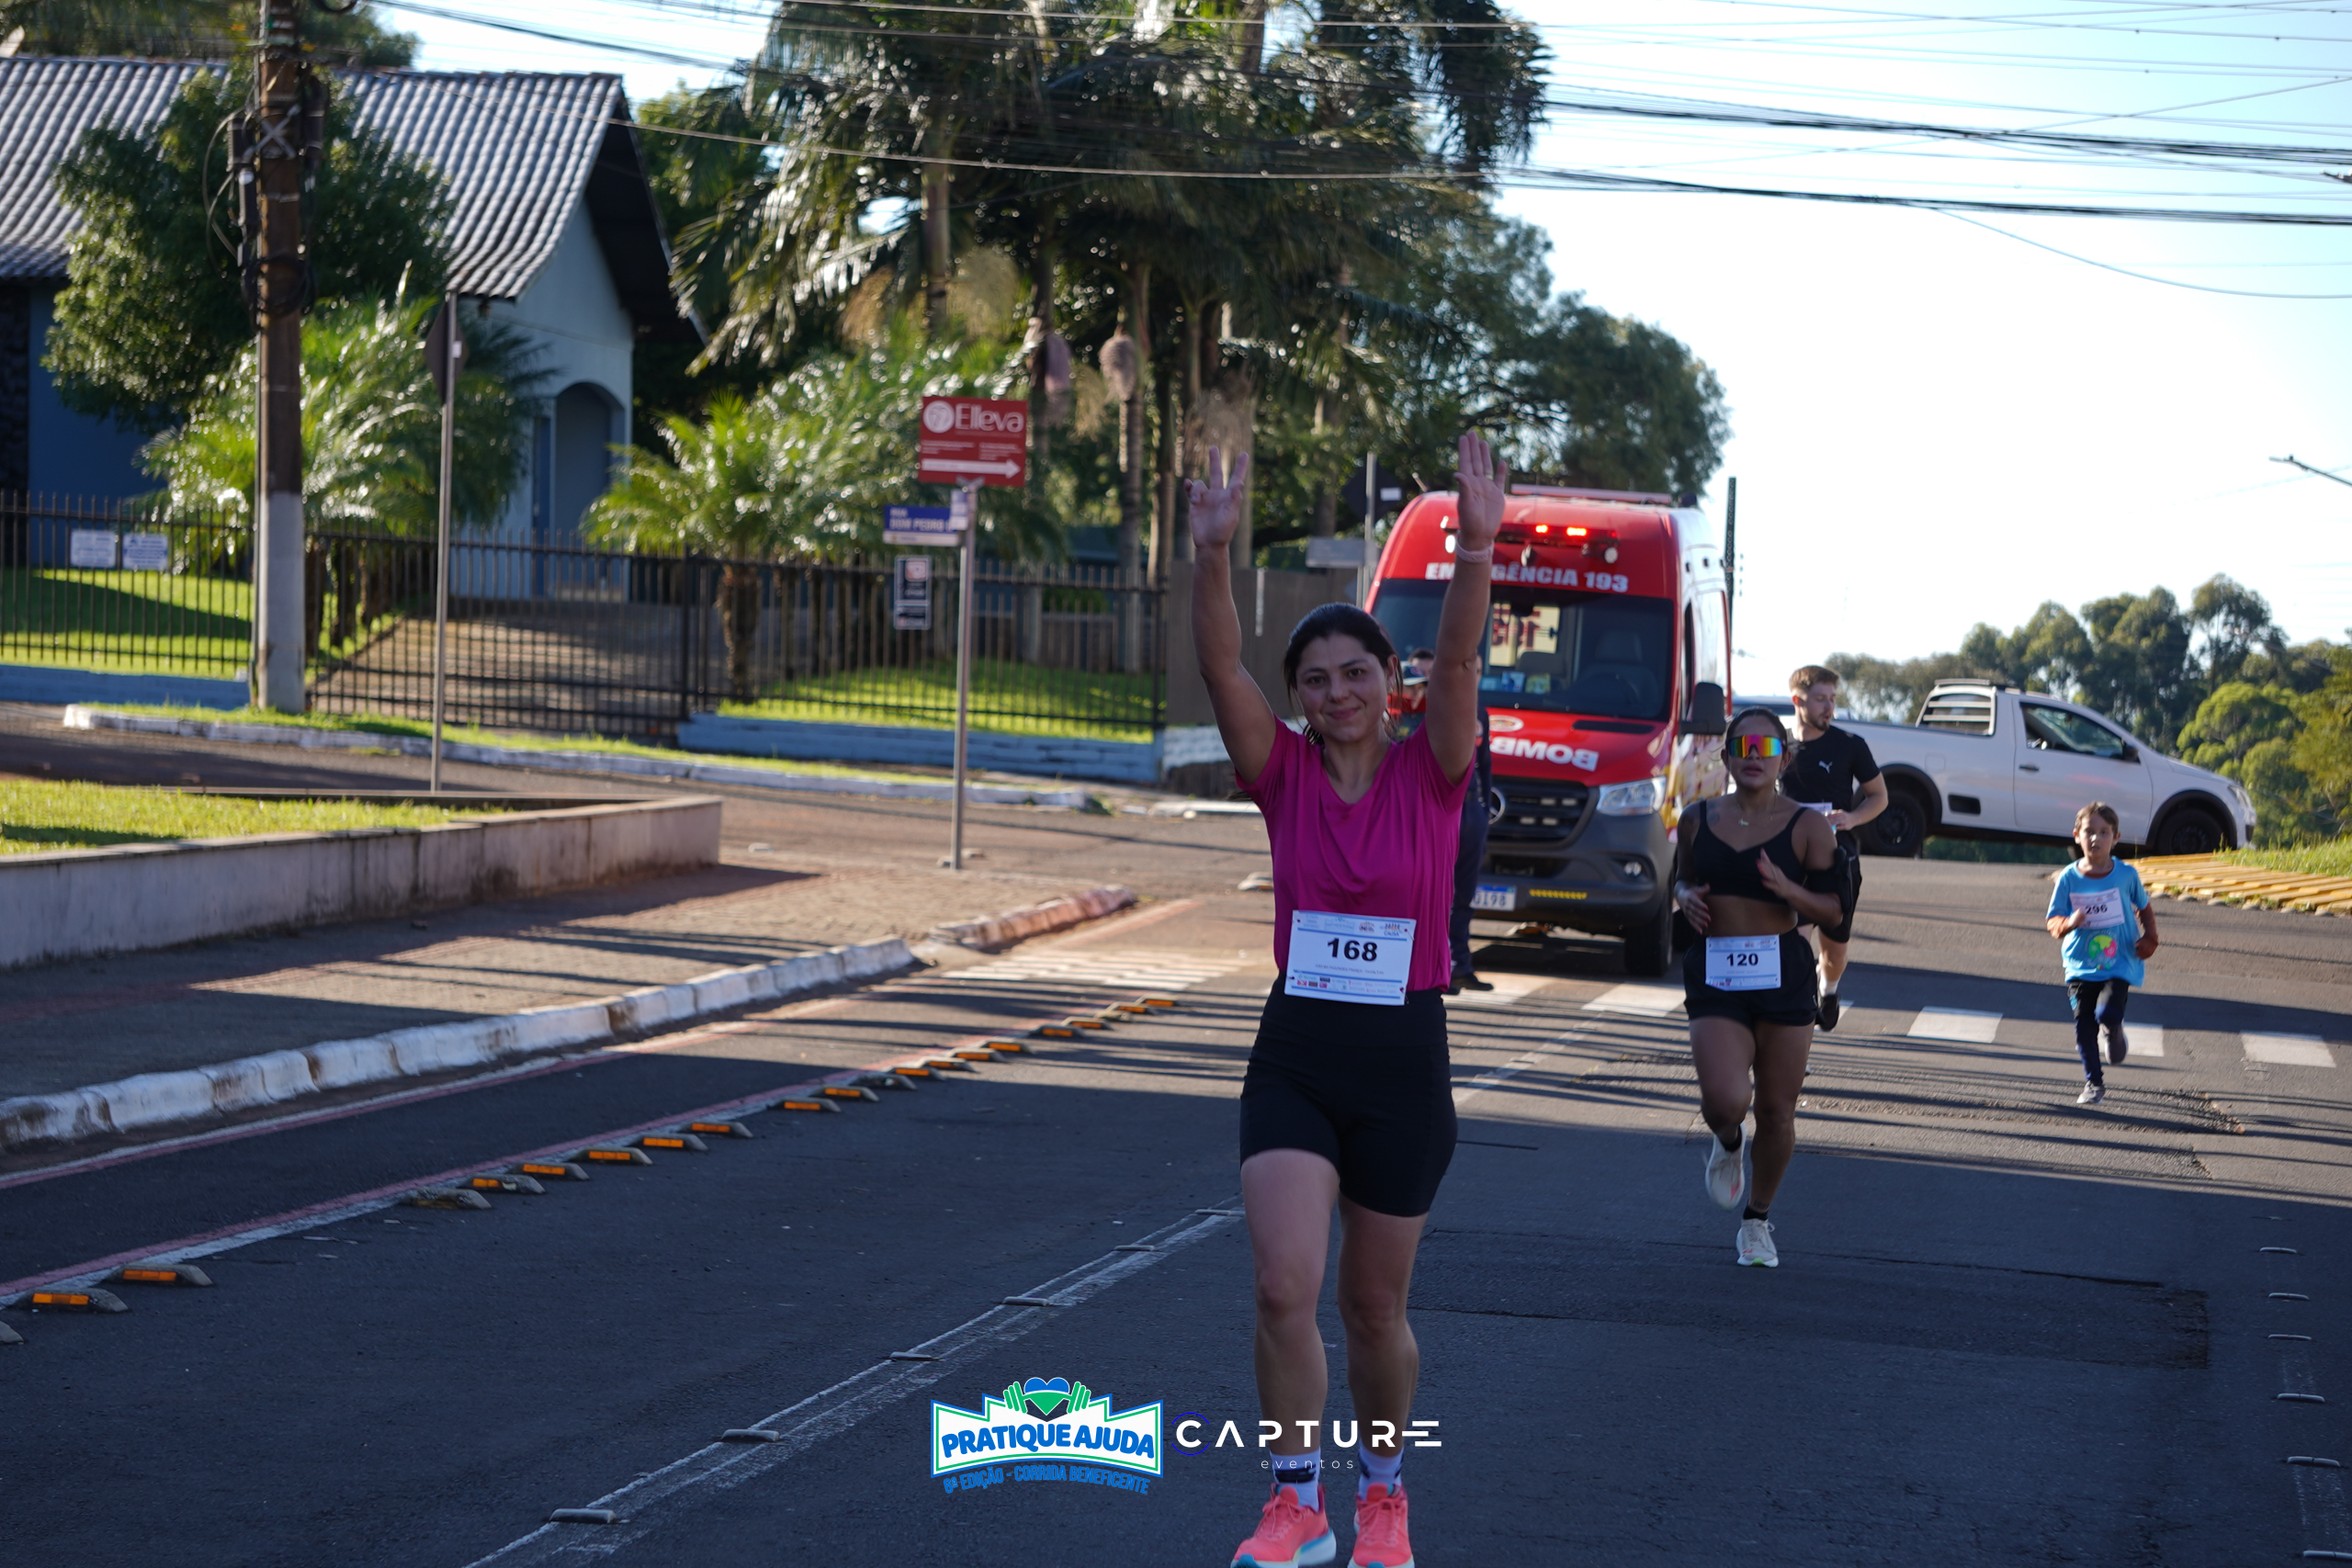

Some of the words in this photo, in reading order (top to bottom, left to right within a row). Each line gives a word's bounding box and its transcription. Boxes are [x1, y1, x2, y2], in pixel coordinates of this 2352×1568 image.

[955, 402, 1024, 433] Elleva
[889, 507, 908, 517] RUA
[889, 517, 912, 530] DOM
[913, 518, 944, 531] PEDRO
[1425, 561, 1578, 587] EMGÊNCIA
[1583, 570, 1629, 592] 193
[2085, 903, 2108, 915] 296
[1328, 937, 1377, 962] 168
[1726, 953, 1758, 967] 120
